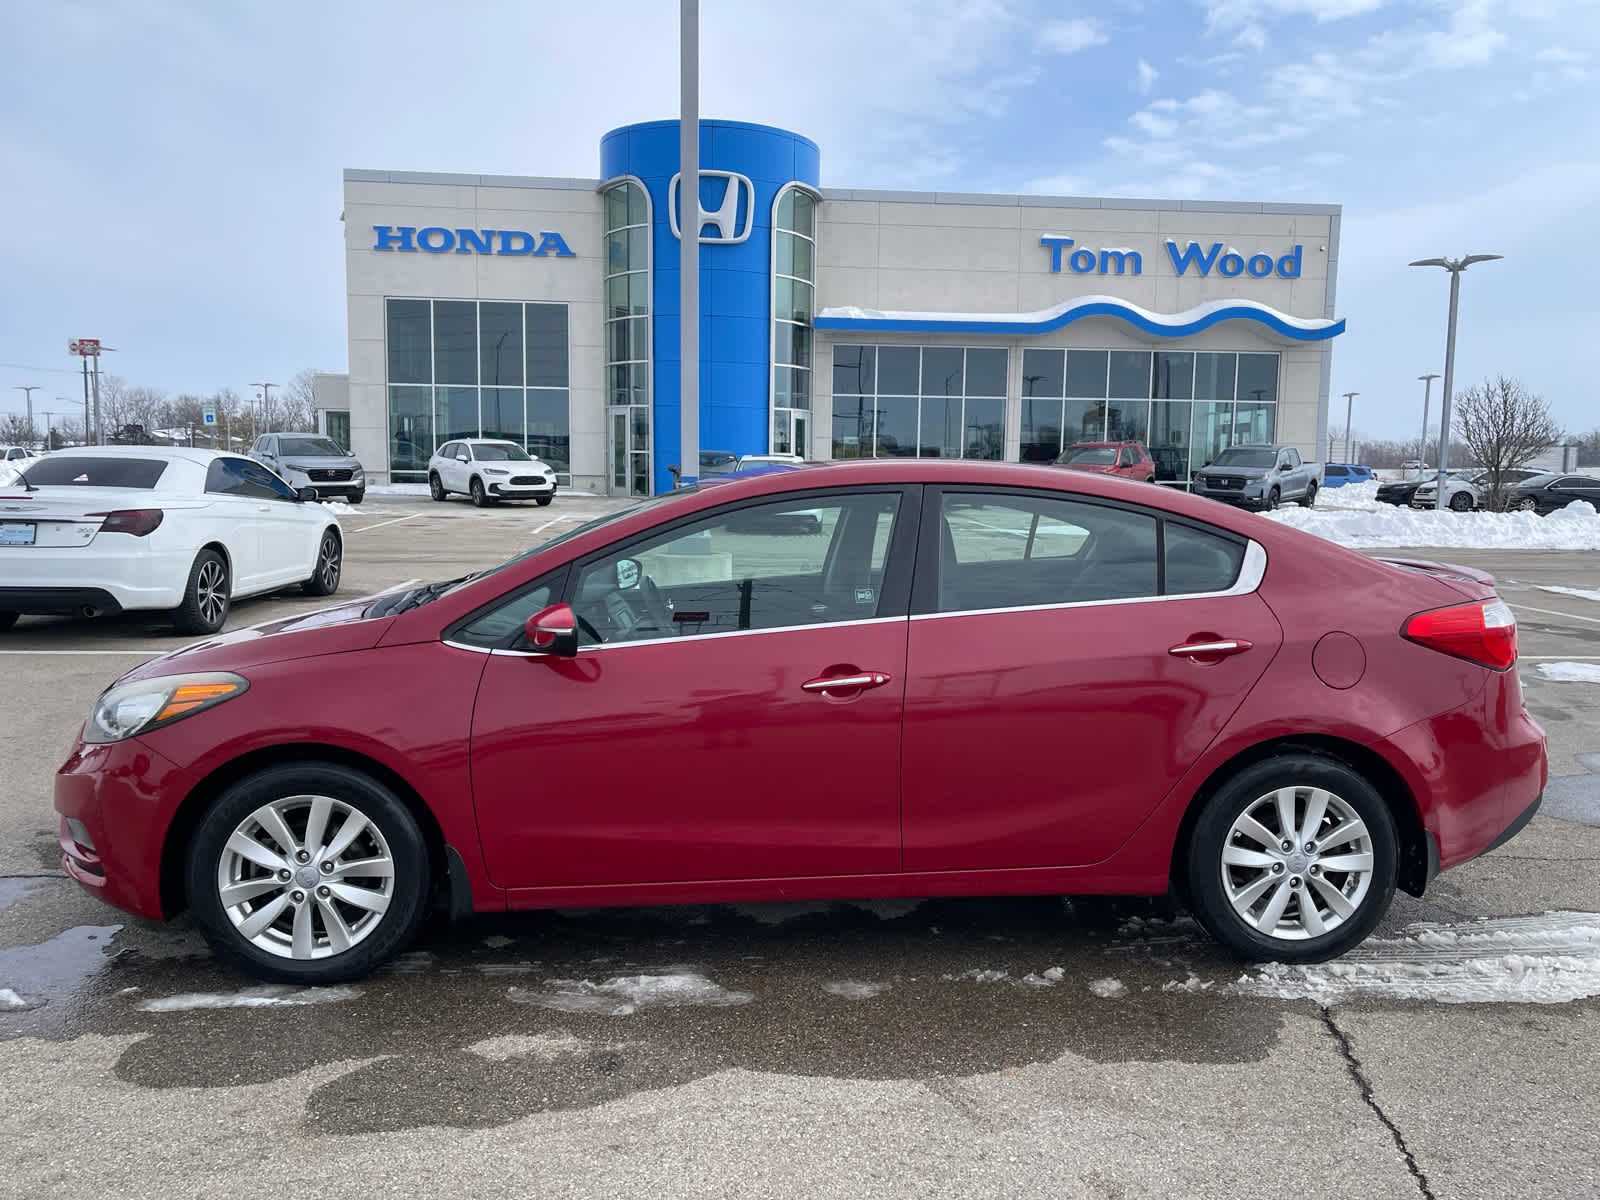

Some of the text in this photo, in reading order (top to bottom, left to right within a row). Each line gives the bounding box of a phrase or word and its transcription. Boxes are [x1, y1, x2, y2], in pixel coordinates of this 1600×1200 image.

[373, 225, 577, 257] HONDA
[1040, 237, 1303, 278] Tom Wood
